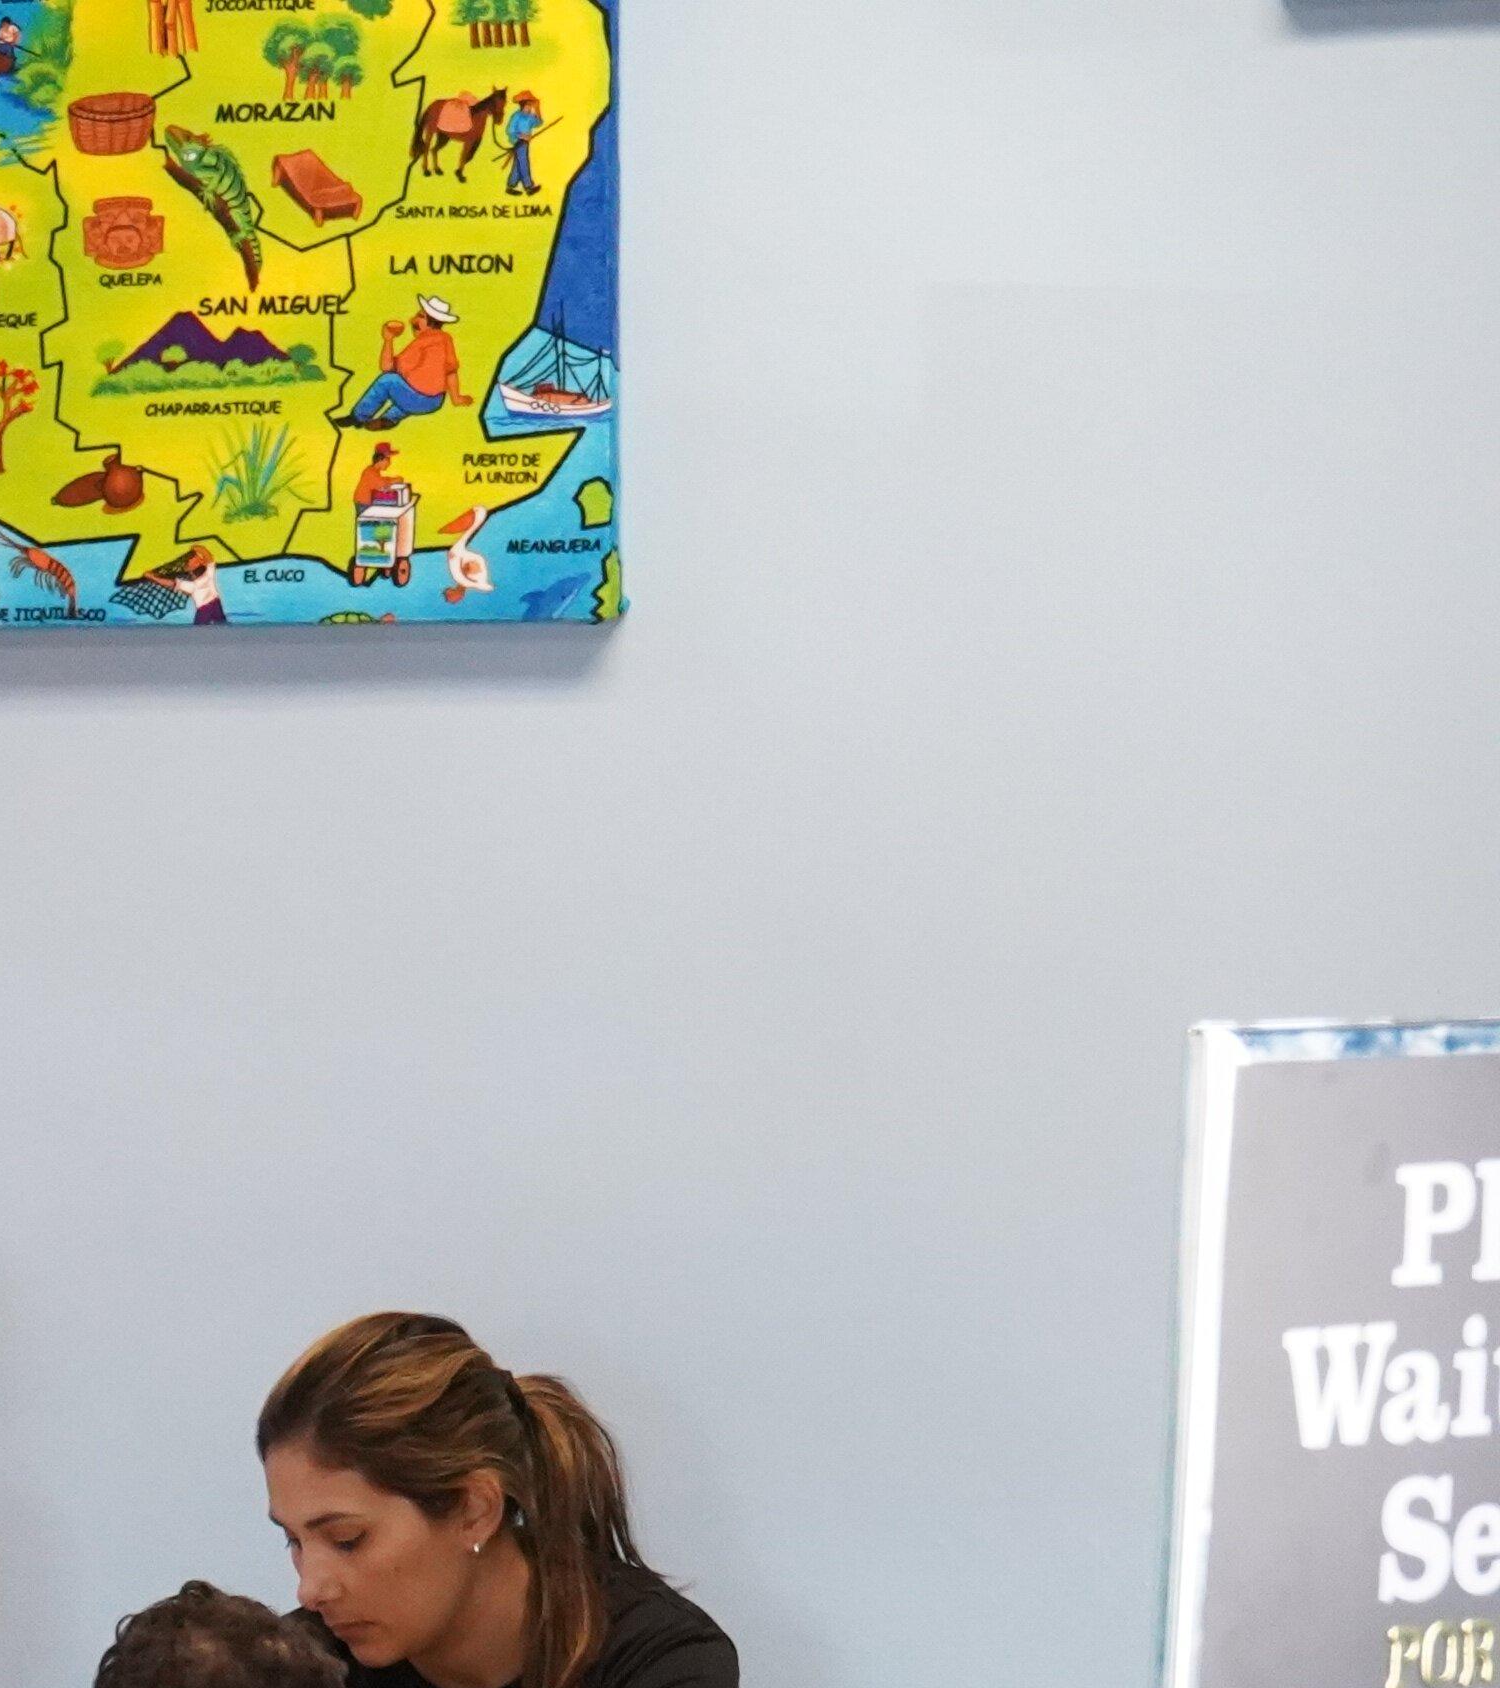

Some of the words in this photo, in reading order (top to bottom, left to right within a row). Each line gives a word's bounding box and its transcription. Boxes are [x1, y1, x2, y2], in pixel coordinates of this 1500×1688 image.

[215, 101, 336, 124] MORAZAN
[395, 205, 445, 220] SANTA
[447, 204, 488, 219] ROSA
[491, 204, 511, 219] DE
[513, 203, 553, 219] LIMA
[389, 255, 422, 275] LA
[428, 253, 514, 275] UNION
[98, 272, 163, 289] QUELEPA
[198, 296, 252, 317] SAN
[257, 294, 350, 317] MIGUEL
[144, 400, 282, 418] CHAPARRASTIQUE
[463, 453, 519, 469] PUERTO
[522, 452, 541, 468] DE
[464, 470, 483, 485] LA
[486, 469, 538, 485] UNION
[506, 538, 602, 555] MEANGUERA
[244, 568, 261, 584] EL
[264, 567, 305, 583] CUCO
[1282, 1313, 1500, 1451] Wai
